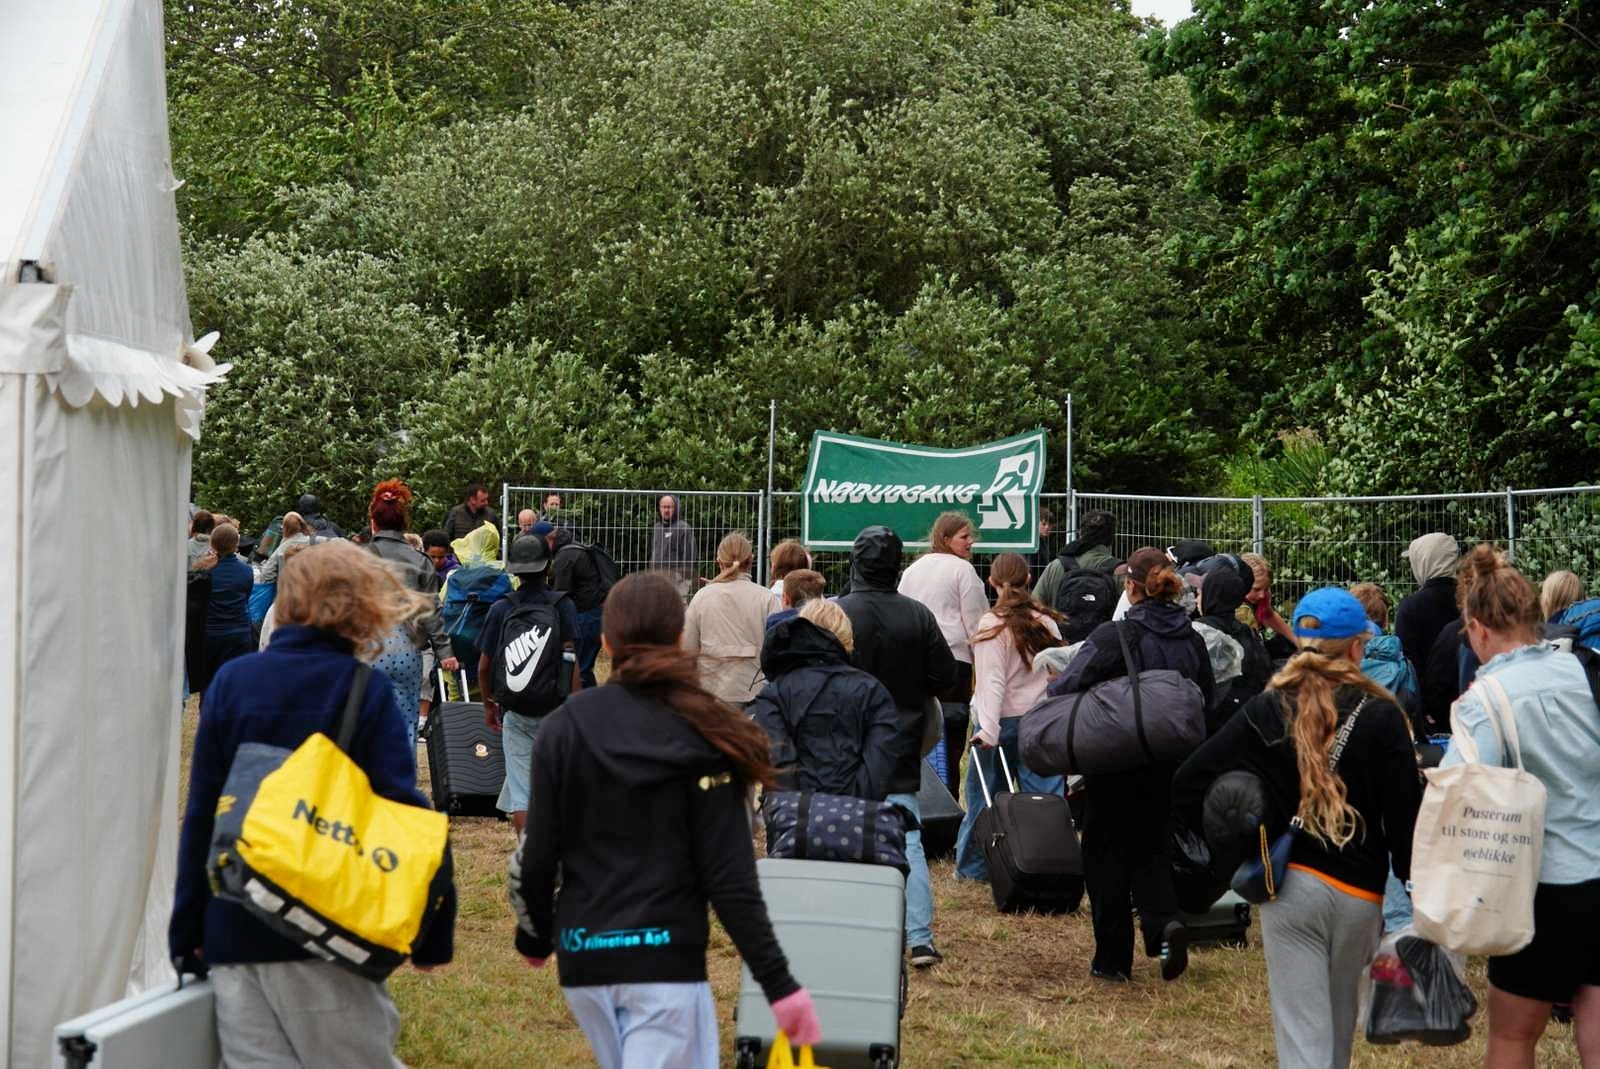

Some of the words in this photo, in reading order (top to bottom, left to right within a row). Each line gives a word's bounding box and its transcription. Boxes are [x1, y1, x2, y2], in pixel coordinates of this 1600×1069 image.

[813, 478, 981, 503] NØDUDGANG
[504, 625, 543, 673] NIKE
[1462, 805, 1522, 824] Pusterum
[1441, 825, 1456, 837] til
[1459, 827, 1490, 840] store
[1492, 832, 1509, 845] og
[1511, 834, 1532, 846] sm
